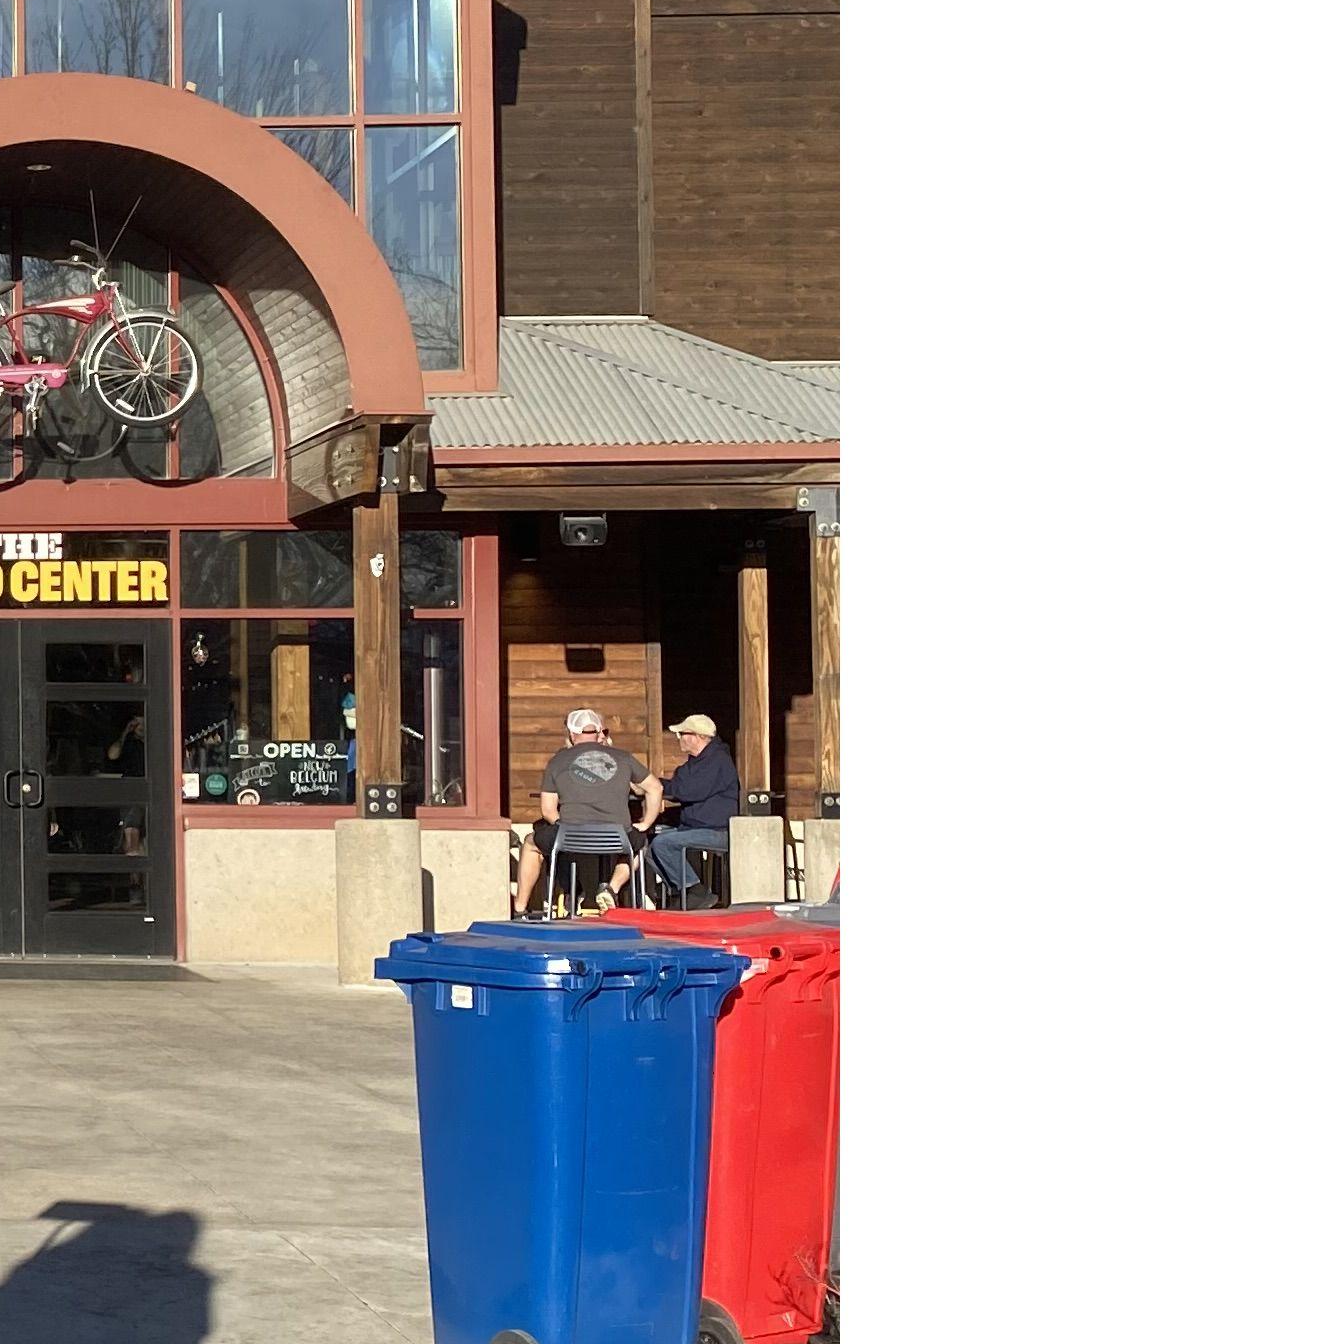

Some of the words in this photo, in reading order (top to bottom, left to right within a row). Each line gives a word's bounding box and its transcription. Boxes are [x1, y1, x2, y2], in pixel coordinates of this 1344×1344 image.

[10, 560, 169, 603] CENTER
[263, 743, 316, 758] OPEN
[290, 770, 338, 784] BELGIUM
